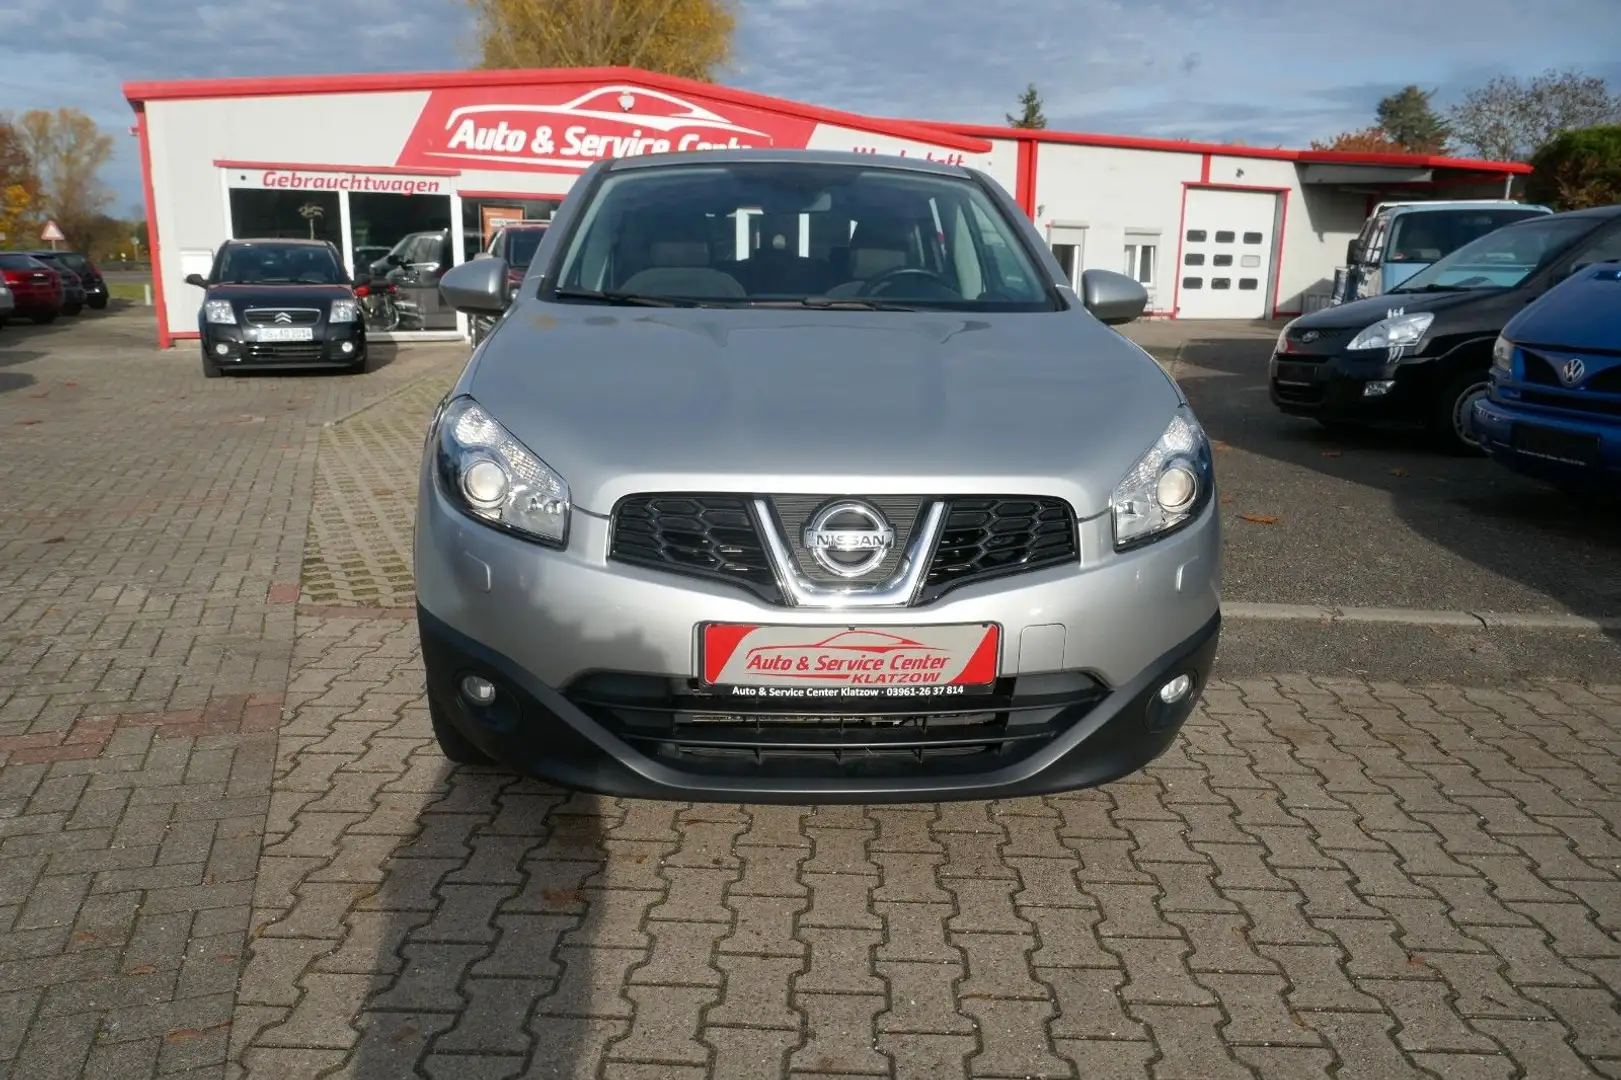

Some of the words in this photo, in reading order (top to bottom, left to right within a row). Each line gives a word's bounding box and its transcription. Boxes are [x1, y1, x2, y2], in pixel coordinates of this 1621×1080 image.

[447, 118, 527, 153] Auto
[530, 125, 555, 154] &
[559, 125, 671, 158] Service
[262, 171, 440, 196] Gebrauchtwagen
[816, 534, 885, 547] NISSAN
[746, 654, 793, 671] Auto
[796, 655, 810, 671] &
[814, 654, 885, 671] Service
[889, 653, 951, 671] Center
[851, 672, 942, 684] KLATZOW
[731, 686, 756, 697] Auto
[758, 686, 767, 697] &
[769, 686, 804, 697] Service
[806, 687, 839, 697] Center
[841, 686, 880, 697] Klatzow
[886, 686, 931, 697] 03961-26
[932, 686, 945, 696] 37
[946, 684, 965, 695] 814
